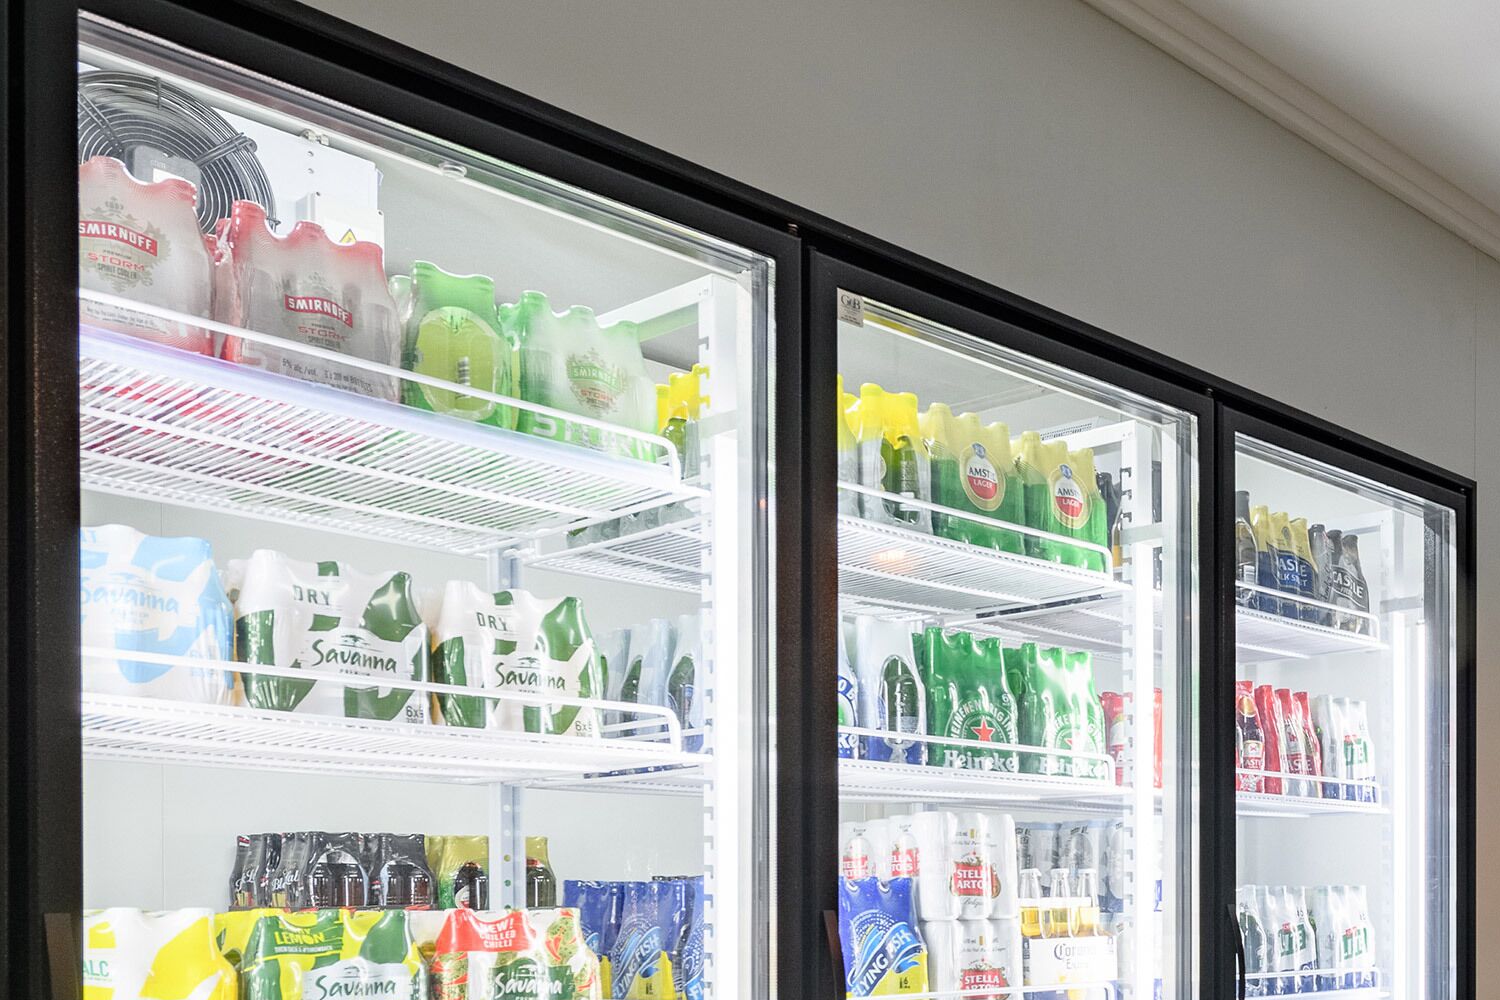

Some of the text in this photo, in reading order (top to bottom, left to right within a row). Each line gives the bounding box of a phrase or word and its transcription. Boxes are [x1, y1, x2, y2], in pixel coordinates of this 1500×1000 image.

[79, 222, 155, 251] SMIRNOFF
[287, 297, 350, 323] SMIRNOFF
[972, 479, 994, 491] LAGER
[476, 611, 508, 632] DRY
[311, 639, 398, 674] Savanna
[274, 931, 325, 946] LEMON
[482, 938, 513, 949] CHILLI
[634, 932, 661, 965] FISH
[315, 974, 397, 1000] Savanna
[964, 974, 1000, 986] STELLA
